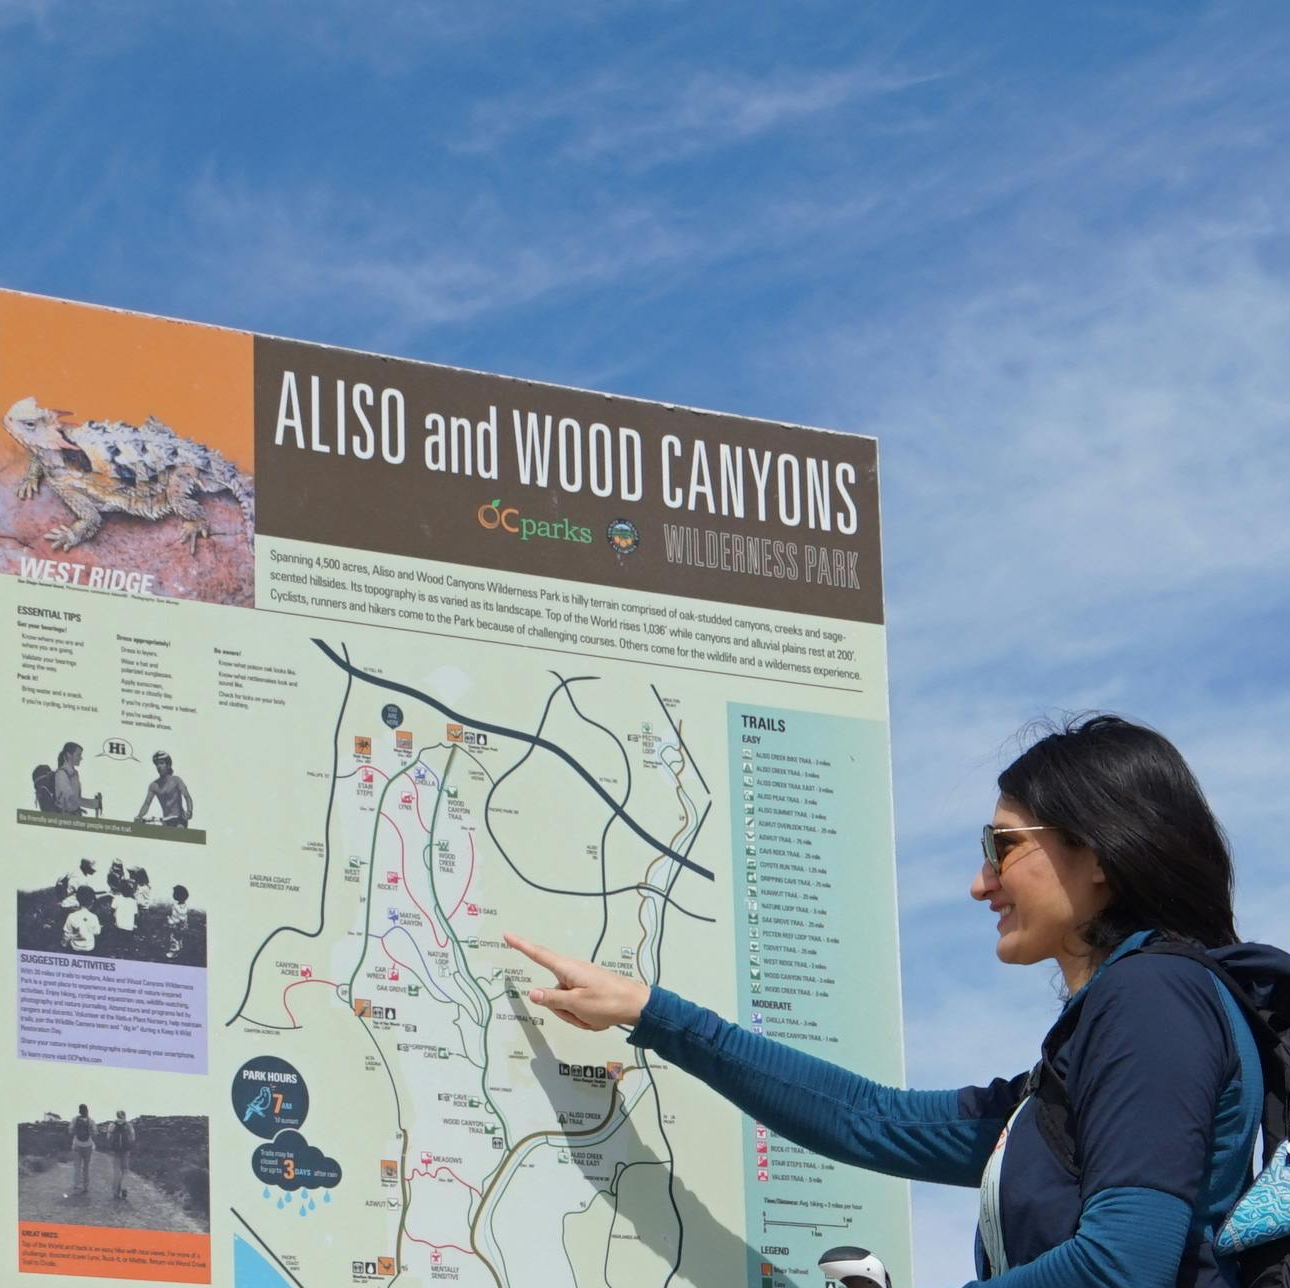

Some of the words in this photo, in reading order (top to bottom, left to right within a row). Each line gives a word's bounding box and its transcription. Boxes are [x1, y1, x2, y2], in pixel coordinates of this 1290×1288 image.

[275, 371, 405, 464] ALISO
[424, 405, 498, 480] and
[513, 409, 642, 502] WOOD
[661, 435, 858, 535] CANYONS
[664, 524, 799, 580] WILDERNESS
[805, 545, 860, 590] PARK
[19, 557, 85, 586] WEST
[89, 567, 155, 594] RIDGE
[270, 549, 313, 568] Spanning
[315, 556, 340, 569] 4,500
[342, 563, 369, 575] acres,
[372, 564, 395, 577] Aliso
[397, 570, 414, 580] and
[415, 571, 443, 585] Wood
[446, 575, 485, 591] Canyons
[486, 581, 537, 598] Wilderness
[540, 589, 560, 601] Park
[562, 592, 569, 603] is
[571, 593, 588, 607] hilly
[590, 597, 619, 610] terrain
[621, 603, 666, 617] comprised
[668, 608, 677, 618] of
[679, 610, 732, 626] oak-studded
[734, 619, 772, 632] canyons,
[774, 624, 803, 636] creeks
[805, 628, 820, 638] and
[822, 632, 845, 643] sage-
[17, 605, 62, 620] ESSENTIAL
[64, 612, 82, 622] TIPS
[270, 571, 307, 584] scented
[309, 574, 348, 590] hillsides.
[351, 580, 362, 592] Its
[364, 584, 416, 602] topography
[418, 590, 425, 601] is
[427, 594, 438, 603] as
[440, 595, 468, 607] varied
[470, 600, 481, 609] as
[483, 599, 493, 611] its
[495, 602, 543, 619] landscape.
[545, 608, 561, 622] Top
[563, 612, 572, 622] of
[574, 613, 588, 624] the
[590, 615, 617, 628] World
[619, 620, 640, 632] rises
[669, 627, 692, 639] while
[695, 632, 731, 644] canyons
[733, 636, 749, 647] and
[751, 638, 779, 650] alluvial
[781, 642, 806, 654] plains
[808, 648, 825, 657] rest
[827, 650, 835, 658] at
[270, 588, 308, 605] Cyclists,
[311, 597, 347, 609] runners
[349, 601, 365, 612] and
[368, 602, 395, 616] hikers
[398, 609, 423, 620] come
[425, 612, 434, 622] to
[437, 612, 451, 624] the
[453, 614, 474, 627] Park
[477, 617, 514, 633] because
[516, 624, 525, 634] of
[527, 625, 577, 644] challenging
[579, 635, 616, 647] courses.
[619, 637, 648, 651] Others
[651, 645, 675, 655] come
[677, 645, 689, 657] for
[690, 648, 704, 659] the
[706, 650, 737, 663] wildlife
[739, 656, 755, 666] and
[757, 659, 763, 667] a
[765, 658, 811, 673] wilderness
[813, 666, 861, 680] experience.
[741, 715, 786, 732] TRAILS
[742, 735, 761, 744] EASY
[109, 742, 126, 755] Hi
[250, 881, 284, 891] WILDERNESS
[285, 884, 300, 892] PARK
[21, 954, 70, 967] SUGGESTED
[71, 959, 116, 971] ACTIVITIES
[275, 961, 299, 969] CANYON
[752, 999, 792, 1011] MODERATE
[243, 1070, 266, 1081] PARK
[268, 1072, 297, 1084] HOURS
[433, 1155, 463, 1165] MEADOWS
[283, 1159, 295, 1179] 3
[295, 1168, 311, 1176] DAYS
[761, 1246, 789, 1256] LEGEND
[431, 1273, 459, 1281] SENSITIVE
